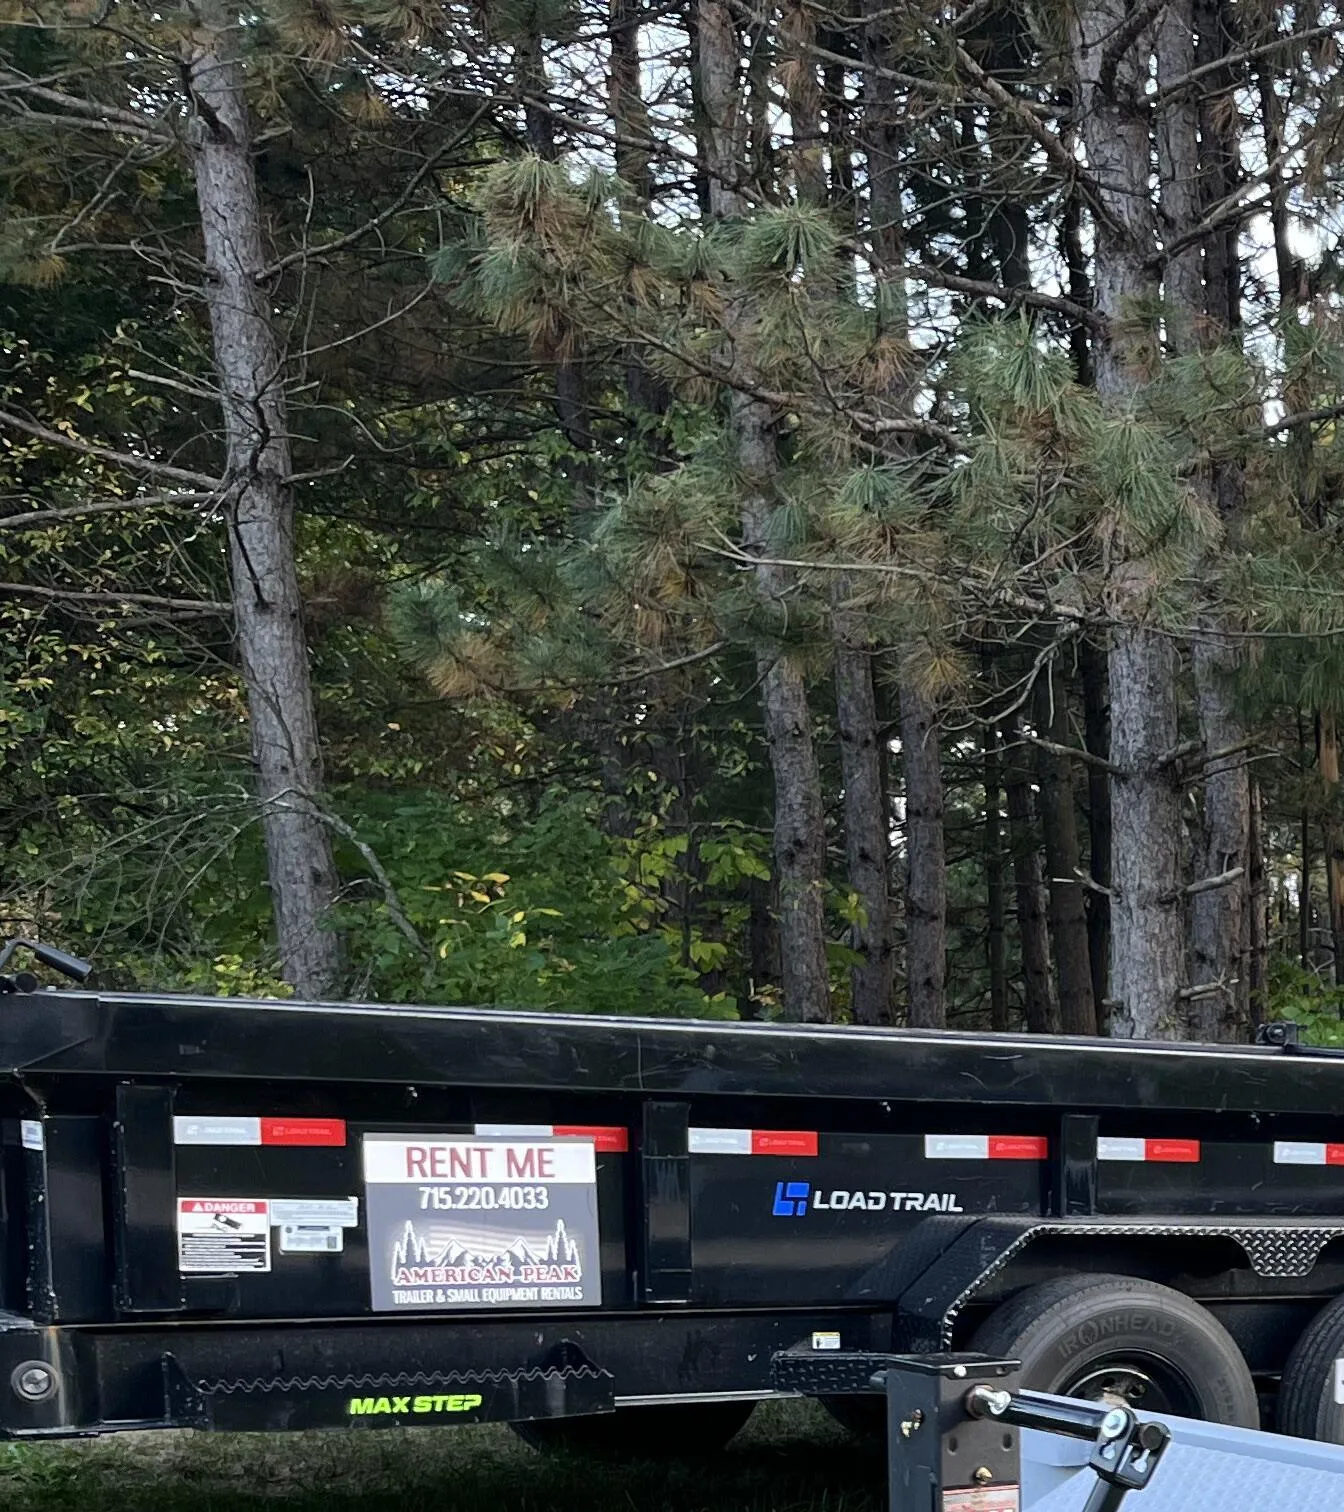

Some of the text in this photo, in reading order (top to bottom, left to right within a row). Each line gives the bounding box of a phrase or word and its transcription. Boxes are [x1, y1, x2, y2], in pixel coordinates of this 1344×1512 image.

[406, 1147, 555, 1178] RENT ME
[202, 1202, 256, 1213] DANGER
[418, 1186, 549, 1209] 715.220.4033
[813, 1190, 963, 1212] LOAD TRAIL
[397, 1264, 580, 1284] AMERICAN PEAK
[392, 1286, 583, 1304] TRAILER & SMALL EQUIPMENT RENTALS
[1058, 1311, 1177, 1358] IRONHEAD
[350, 1395, 482, 1414] MAX STEP
